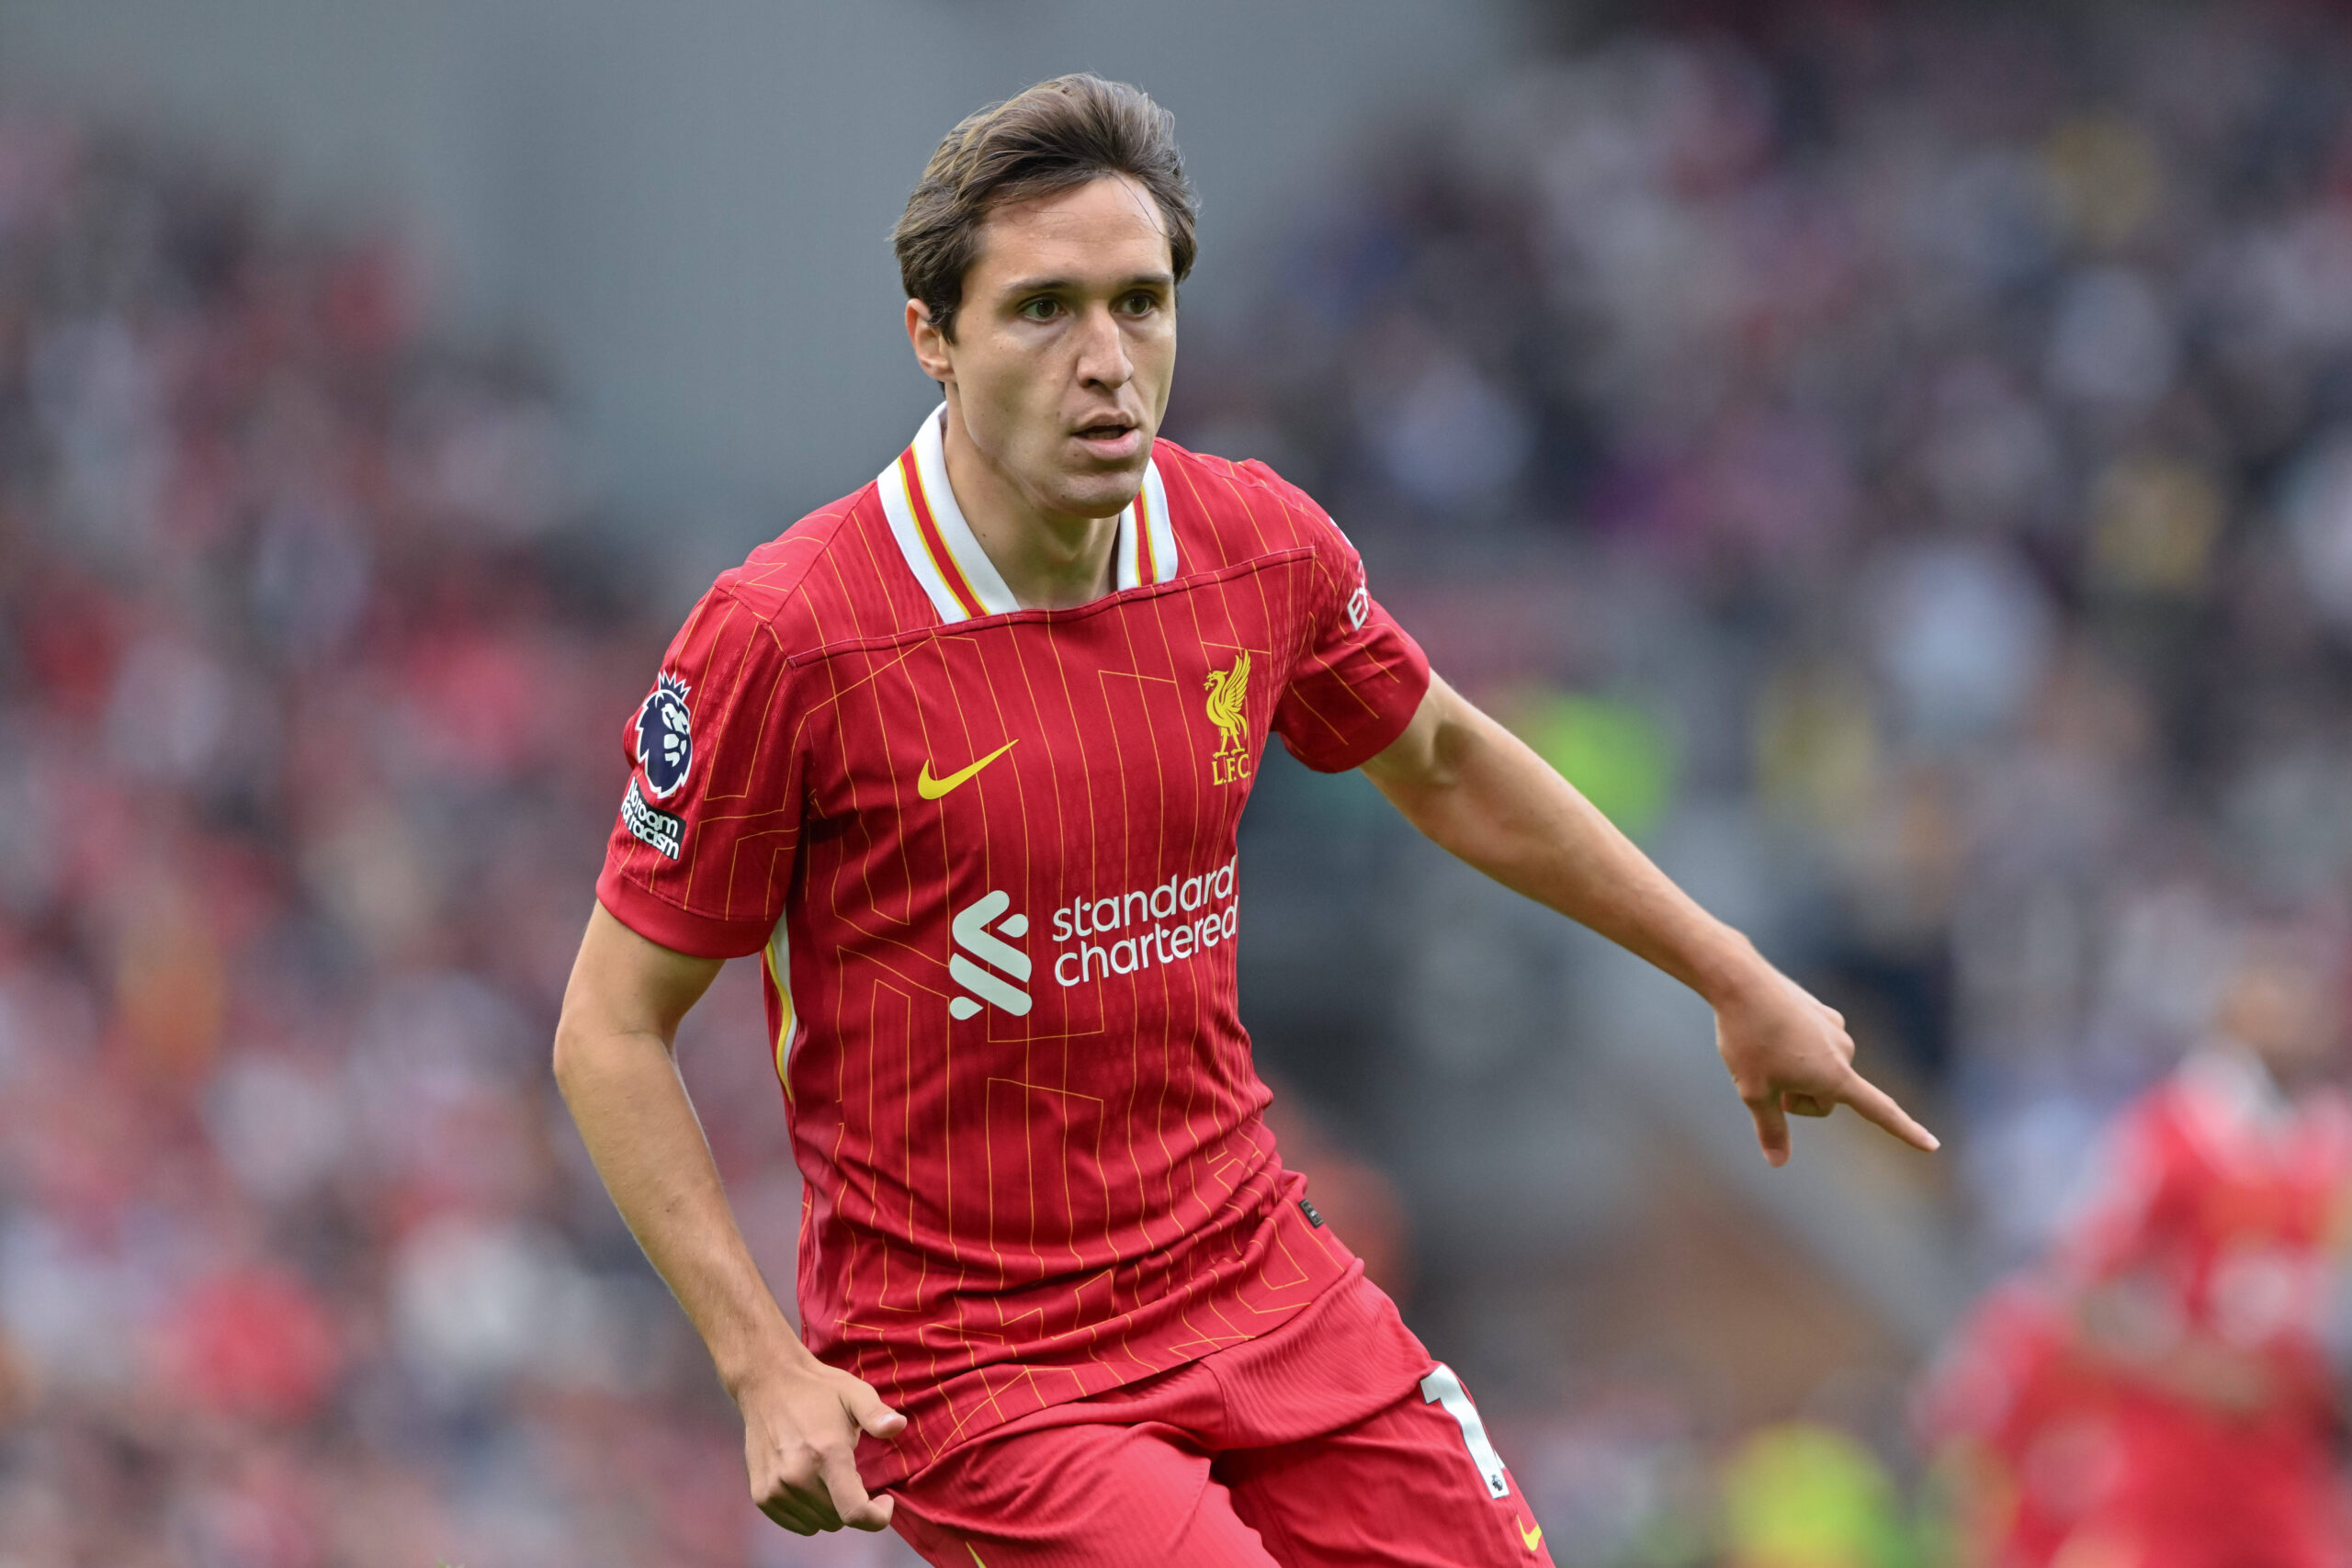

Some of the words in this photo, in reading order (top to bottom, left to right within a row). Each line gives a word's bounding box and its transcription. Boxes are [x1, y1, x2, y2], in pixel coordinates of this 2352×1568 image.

[628, 814, 680, 861] racism
[634, 797, 679, 838] room
[1052, 854, 1237, 942] standard
[1054, 894, 1238, 987] chartered
[1419, 1363, 1510, 1499] 1
